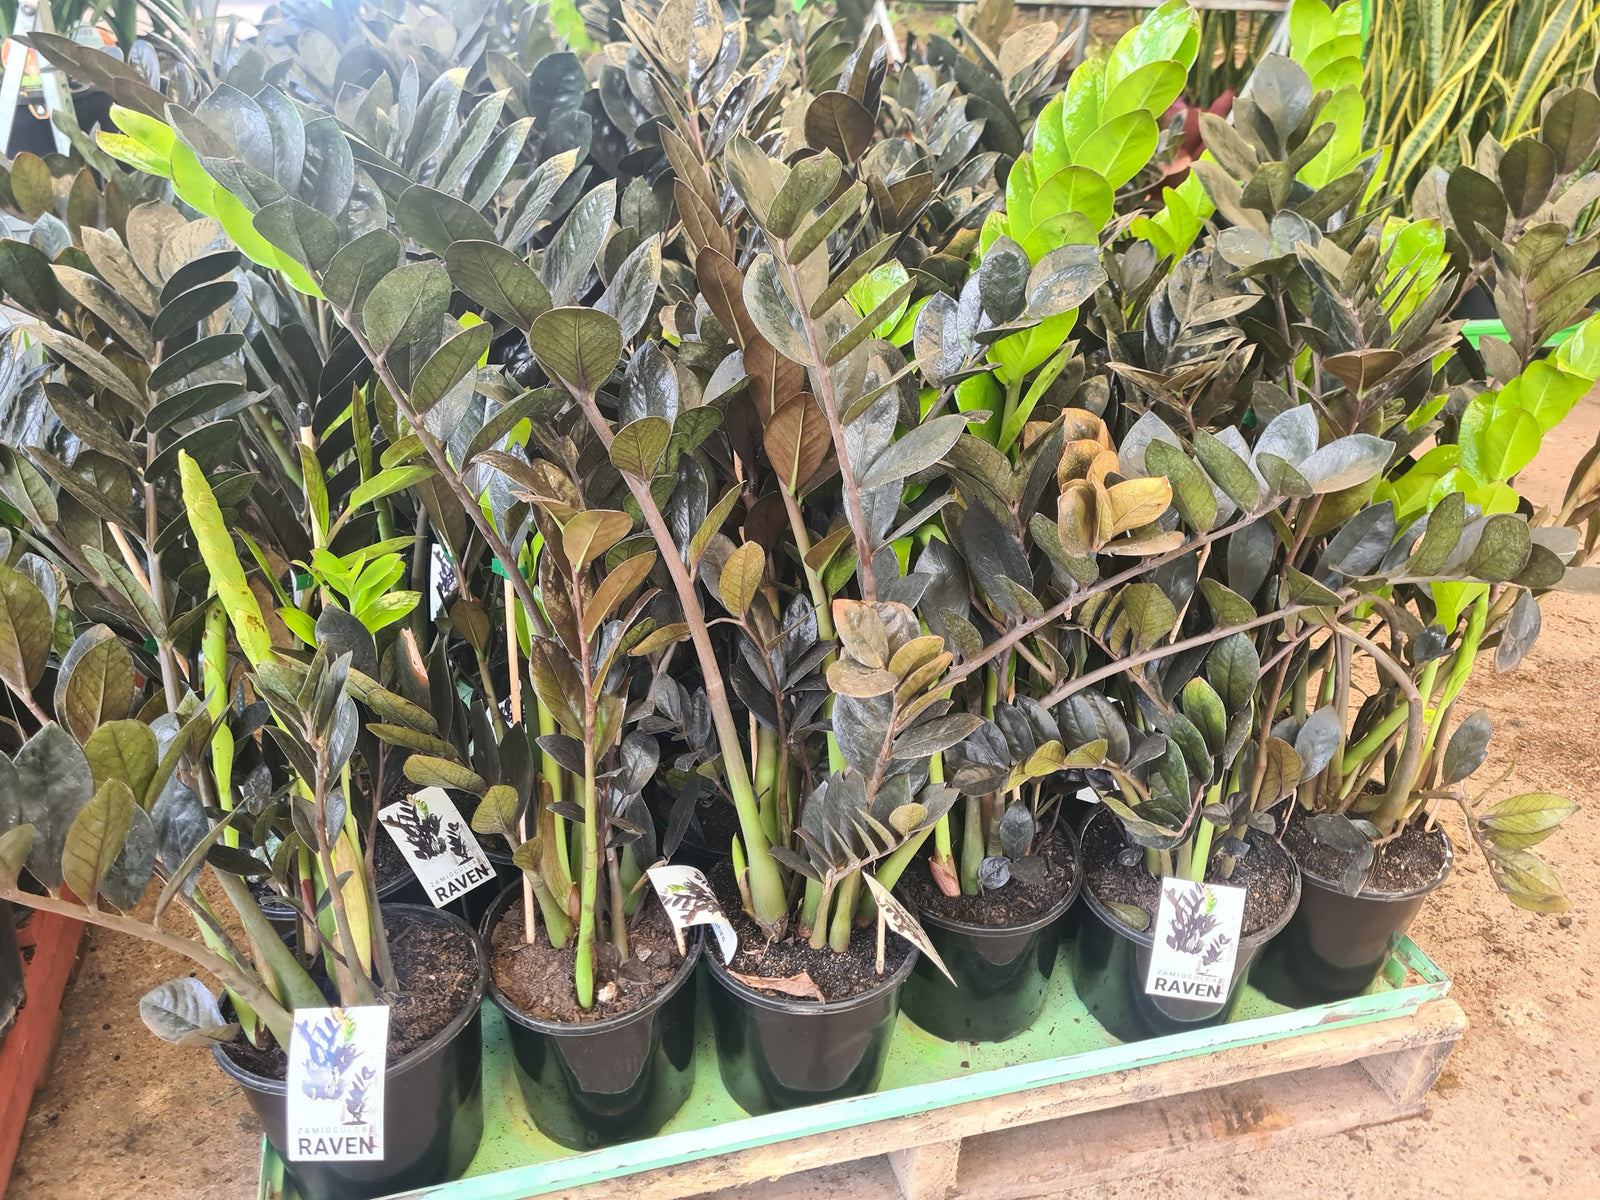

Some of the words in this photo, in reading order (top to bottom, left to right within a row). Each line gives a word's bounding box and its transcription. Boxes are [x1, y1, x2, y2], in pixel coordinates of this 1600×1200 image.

[434, 863, 489, 902] RAVEN
[1154, 977, 1221, 998] RAVEN
[297, 1125, 374, 1134] ZAMIOCULCAS
[298, 1136, 374, 1155] RAVEN
